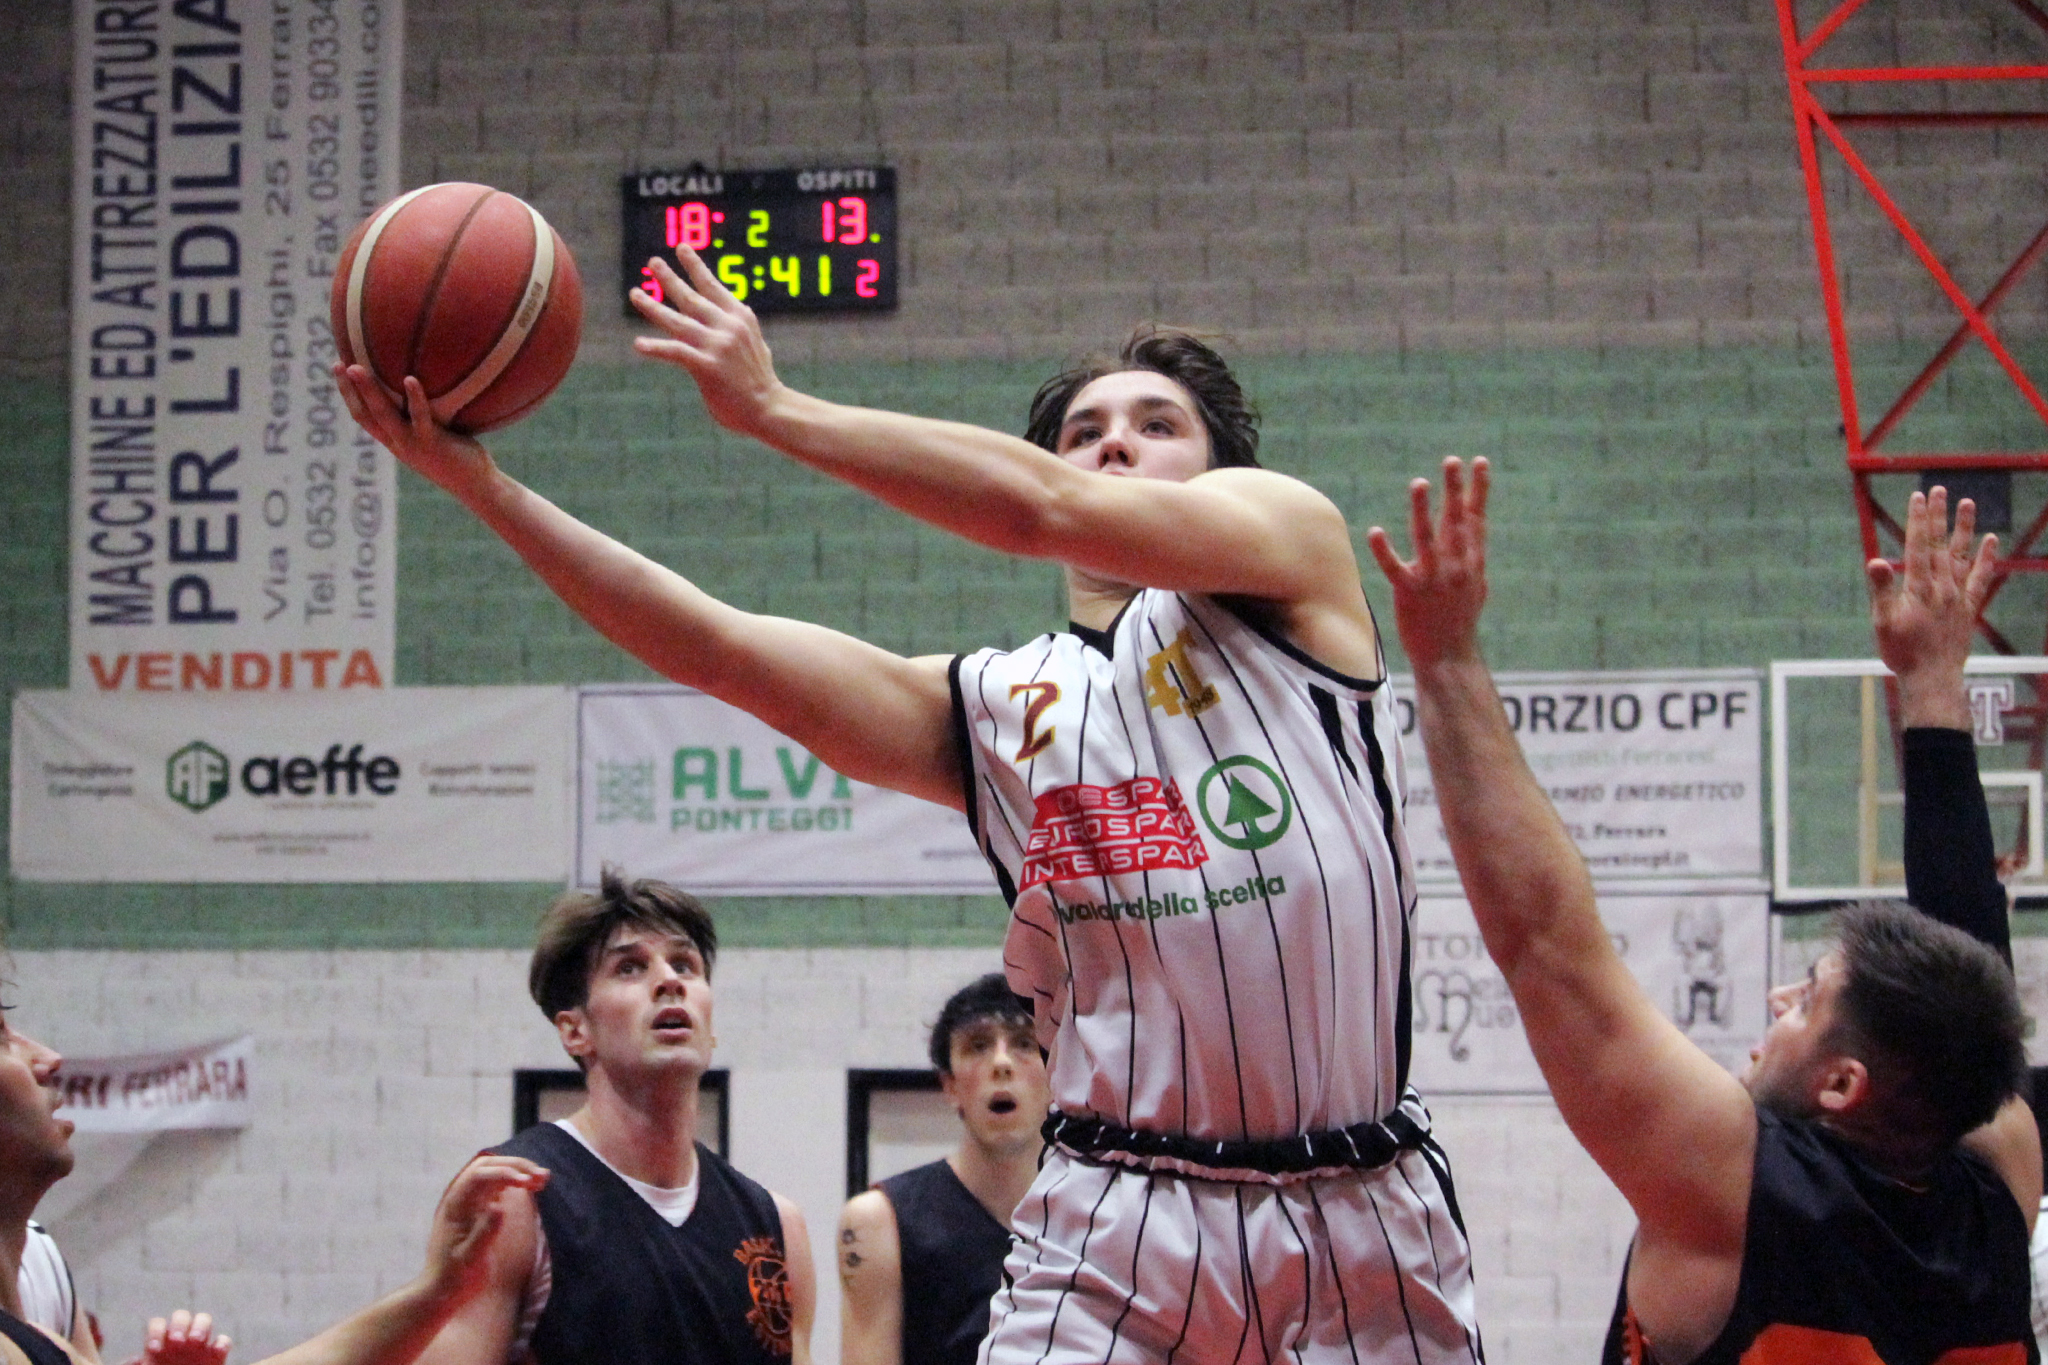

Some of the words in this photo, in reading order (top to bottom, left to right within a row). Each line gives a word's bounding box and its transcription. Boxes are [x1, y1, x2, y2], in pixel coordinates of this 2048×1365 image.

[91, 0, 159, 311] ATTREZZATUR
[308, 114, 340, 202] 0532
[639, 174, 724, 197] LOCALI
[797, 169, 877, 191] OSPITI
[168, 0, 242, 415] L'EDILIZIA
[265, 159, 292, 217] 25
[308, 214, 338, 280] Fax
[747, 209, 770, 248] 2
[855, 259, 880, 298] 2
[90, 324, 157, 380] ED
[263, 236, 296, 456] Respighi,
[305, 315, 338, 448] 904232
[88, 396, 155, 627] MACCHINE
[168, 446, 240, 626] PER
[305, 461, 338, 551] 0532
[262, 546, 289, 622] Via
[303, 562, 335, 626] Tel.
[88, 649, 383, 691] VENDITA
[1009, 680, 1062, 765] 2
[1658, 691, 1749, 731] CPF
[241, 744, 401, 797] aeffe
[671, 807, 853, 832] PONTEGGI
[1024, 840, 1206, 884] INTERSPAR
[1203, 875, 1287, 910] scelta
